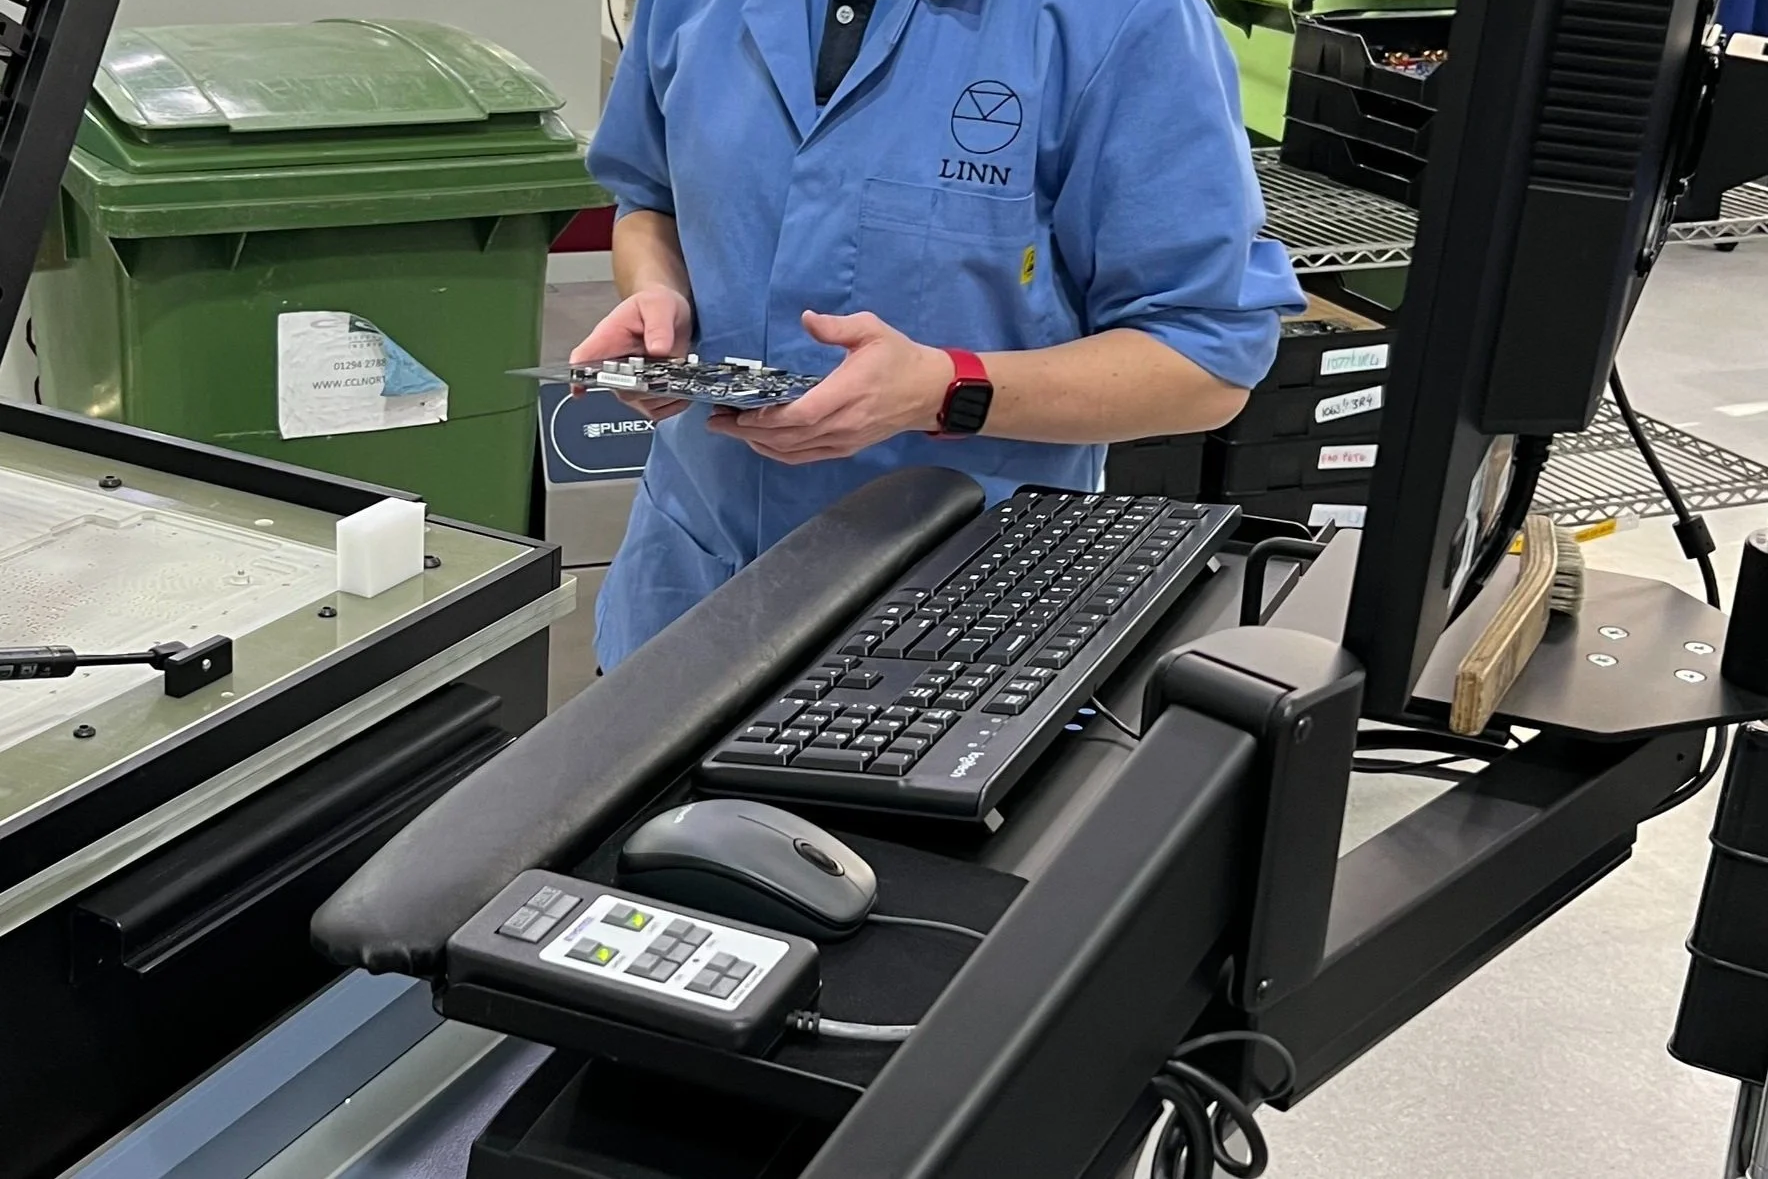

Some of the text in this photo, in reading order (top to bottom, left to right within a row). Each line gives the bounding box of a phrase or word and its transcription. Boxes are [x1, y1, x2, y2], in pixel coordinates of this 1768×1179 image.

[938, 158, 1012, 186] LINN
[333, 360, 362, 371] 01294
[600, 420, 655, 434] PUREX
